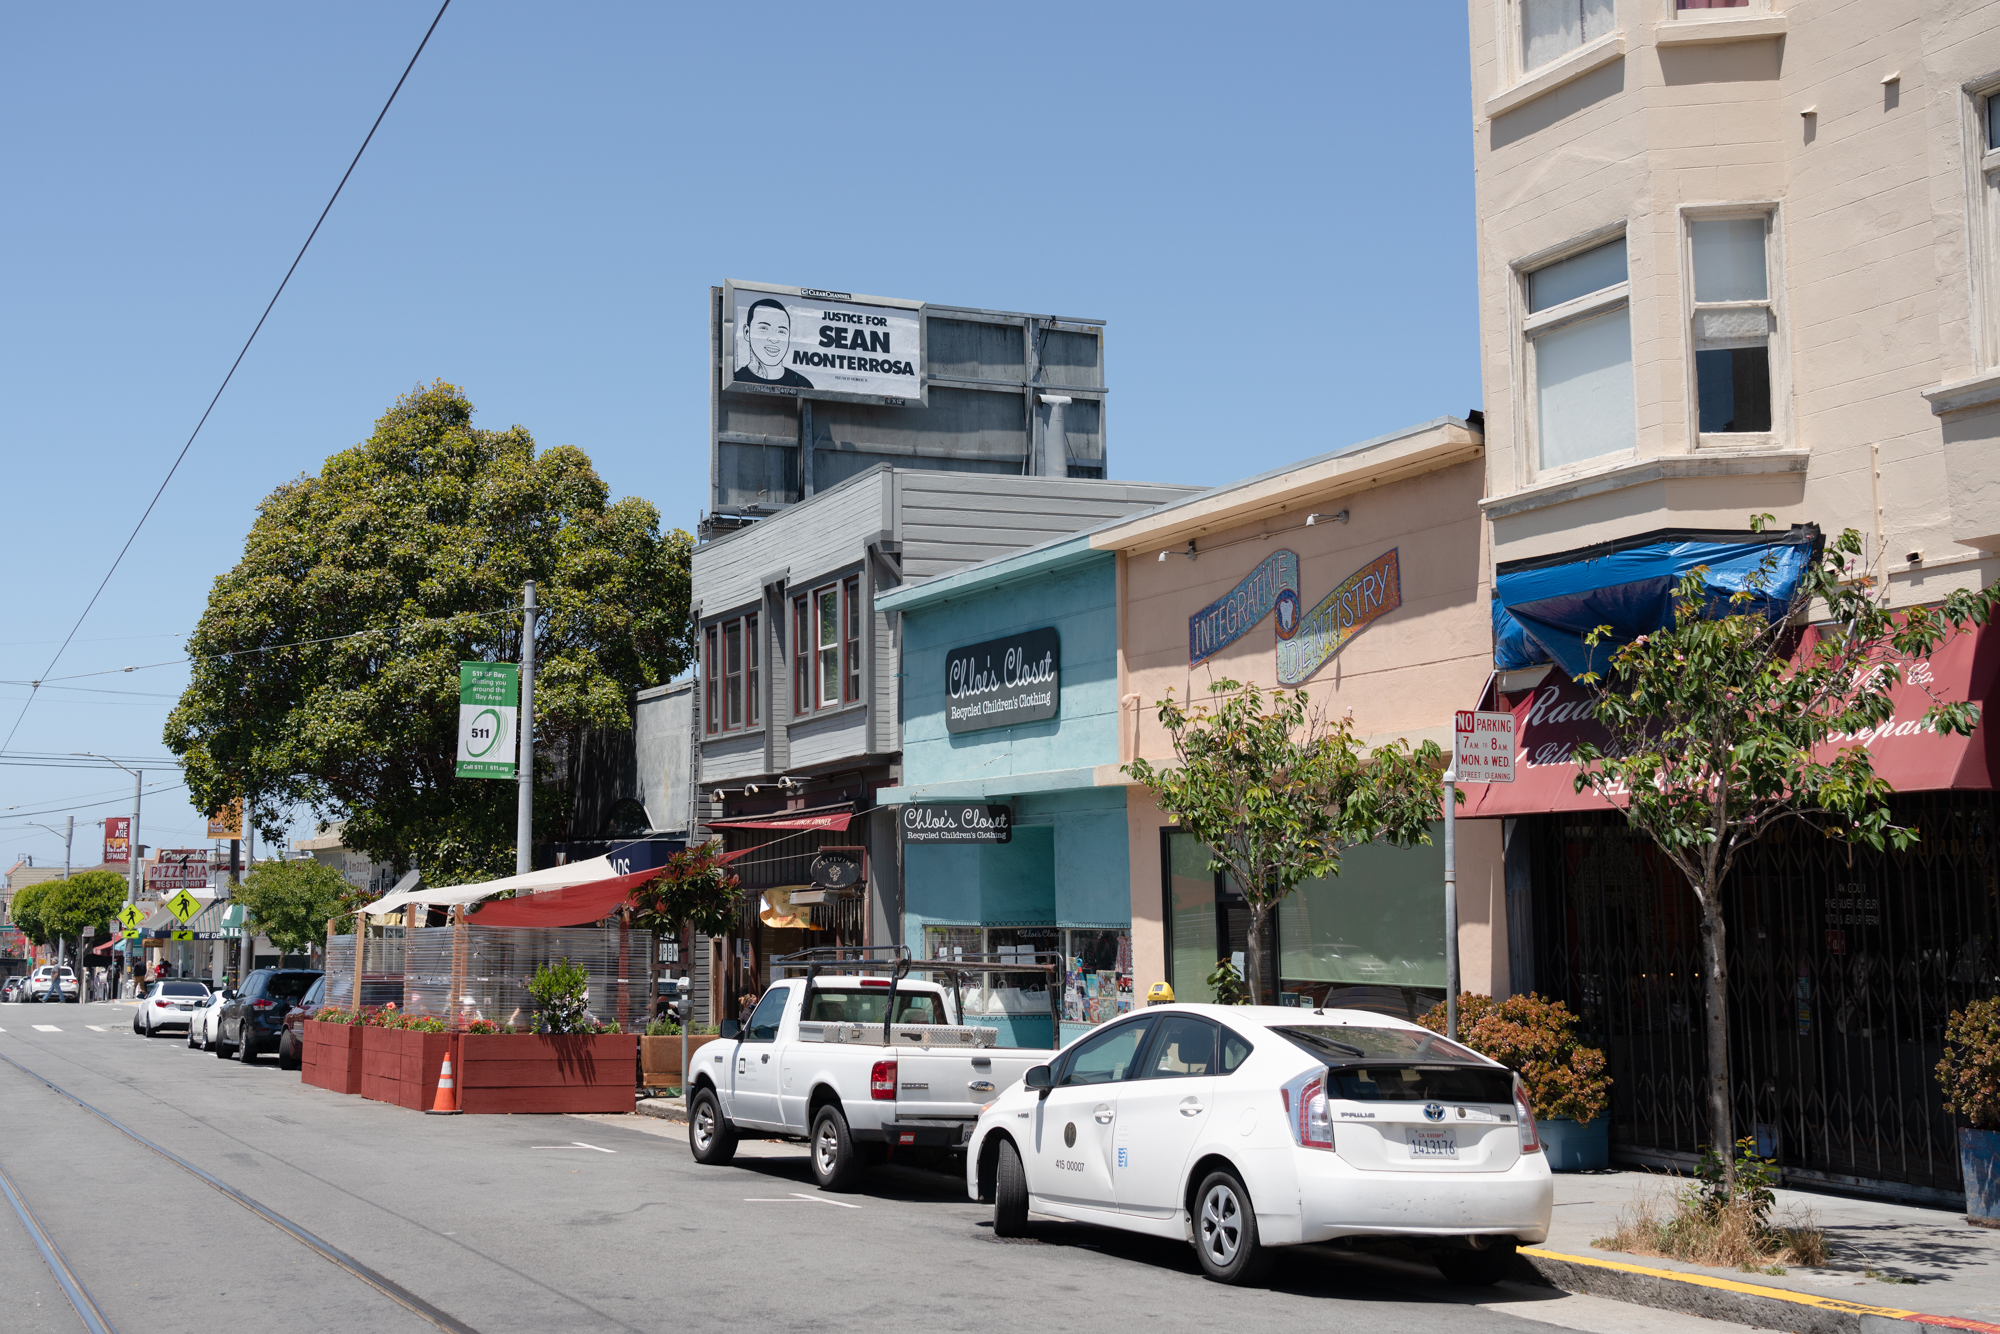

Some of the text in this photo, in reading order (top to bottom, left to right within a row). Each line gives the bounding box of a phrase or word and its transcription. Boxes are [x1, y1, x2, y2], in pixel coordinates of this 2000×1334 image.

[821, 310, 887, 327] JUSTICE FOR
[818, 325, 891, 354] SEAN
[791, 350, 915, 376] MONTERROSA
[1285, 564, 1390, 681] DENTISTRY
[949, 646, 1055, 700] Chloe's Closet
[471, 678, 494, 686] Getting
[950, 690, 1052, 721] Recycled Children's Clothing
[1457, 712, 1512, 733] NO PARKING
[471, 728, 490, 739] 511
[1463, 735, 1470, 749] 7
[1490, 737, 1498, 750] 8
[489, 764, 509, 772] 511.org
[1461, 754, 1511, 768] MON. & WED.
[1460, 770, 1511, 780] STREET CLEANING
[117, 821, 129, 830] WE
[903, 808, 1008, 830] Chloe's Closet
[115, 829, 128, 838] ARE
[907, 830, 1007, 841] Recycled Children's Clothing
[106, 852, 127, 860] SFMADE
[1412, 1139, 1455, 1155] 1413176
[1055, 1159, 1085, 1173] 415 00007
